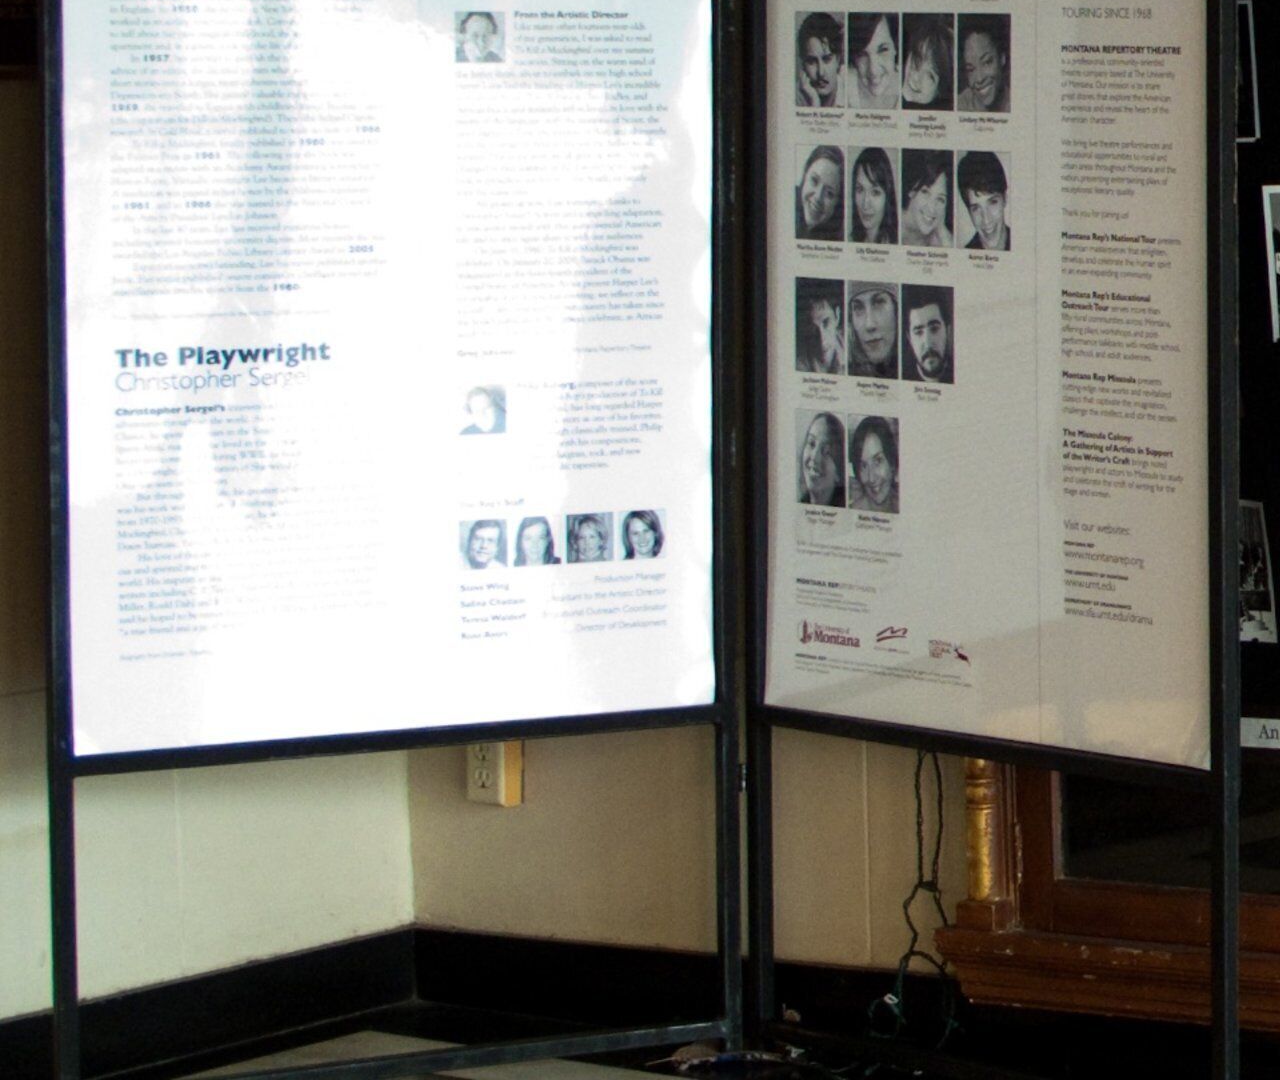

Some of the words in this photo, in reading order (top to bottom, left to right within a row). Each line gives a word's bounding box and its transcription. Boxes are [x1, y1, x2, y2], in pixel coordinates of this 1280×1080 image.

[1061, 7, 1102, 19] TOURING
[1104, 7, 1130, 19] SINCE
[1061, 44, 1100, 55] MONTANA
[1102, 44, 1145, 56] REPERTORY
[1146, 45, 1181, 57] THEATRE
[115, 348, 168, 369] The
[178, 342, 331, 370] Playwright
[115, 371, 242, 395] Christopher
[1063, 427, 1076, 438] The
[813, 629, 861, 648] Montana
[1258, 723, 1280, 741] An
